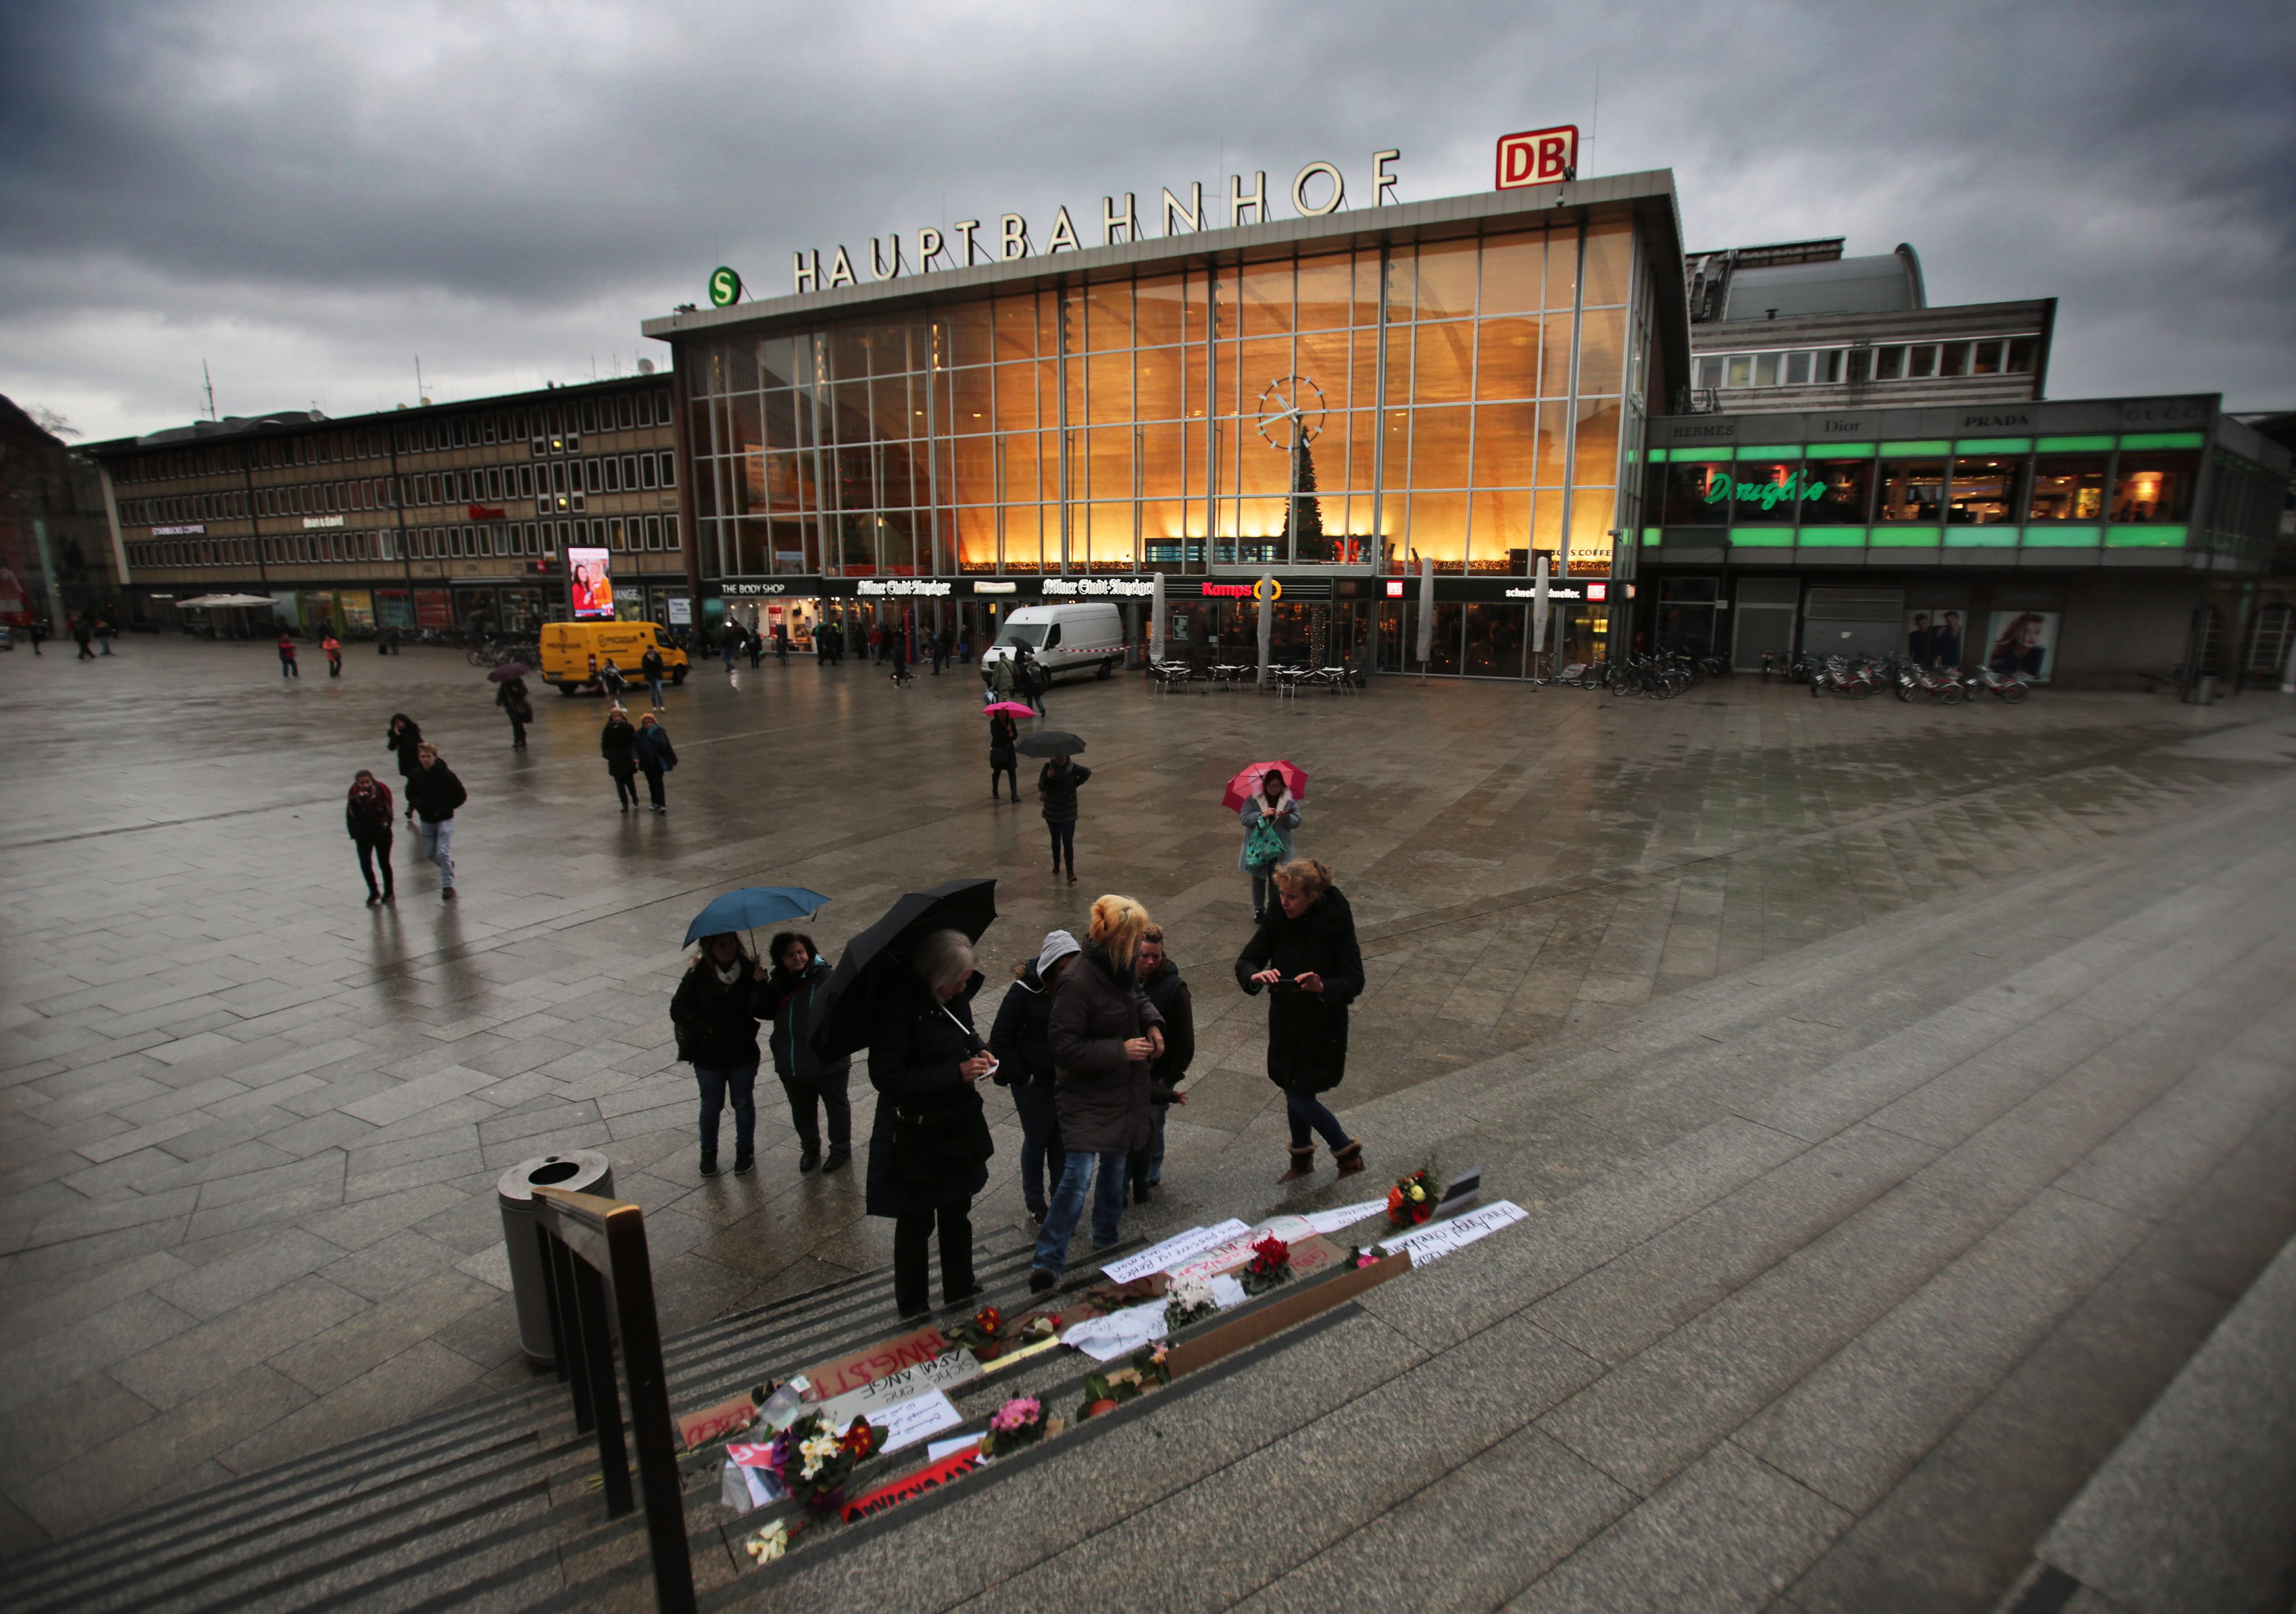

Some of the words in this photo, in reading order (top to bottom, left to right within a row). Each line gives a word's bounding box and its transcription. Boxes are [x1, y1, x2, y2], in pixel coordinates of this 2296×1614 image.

[1506, 137, 1566, 183] DB
[793, 149, 1400, 294] HAUPTBAHNHOF
[715, 271, 732, 304] S
[1825, 419, 1861, 432] Dior
[1965, 415, 2030, 428] PRADA
[1703, 470, 1828, 510] Douglas
[722, 584, 738, 594] THE
[739, 584, 761, 594] BODY
[763, 584, 785, 594] SHOP
[1202, 581, 1252, 599] Kamps
[1548, 588, 1581, 599] chneller.
[881, 1385, 915, 1404] eine
